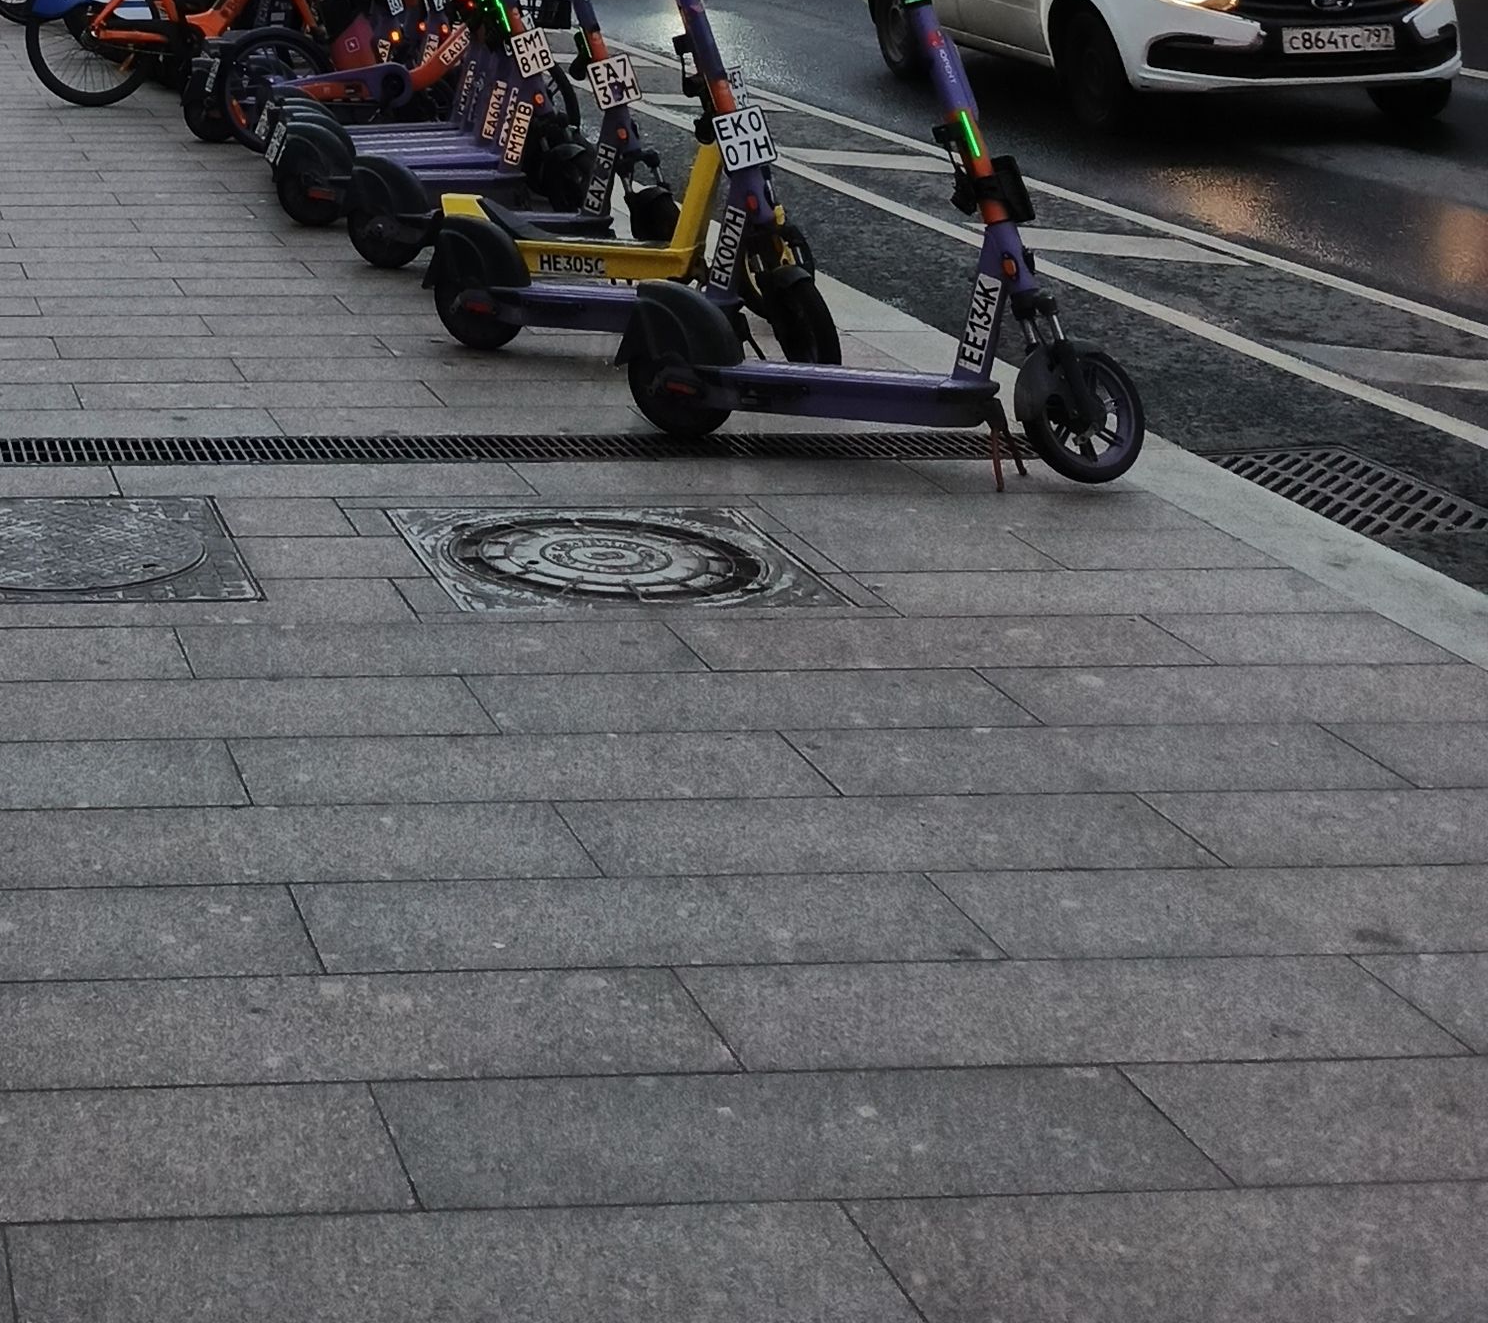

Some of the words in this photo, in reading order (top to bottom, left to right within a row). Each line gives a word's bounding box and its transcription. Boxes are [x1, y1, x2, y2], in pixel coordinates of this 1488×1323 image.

[514, 31, 544, 55] ЕМ1
[1289, 31, 1362, 50] С864ТС
[520, 49, 552, 74] 81В
[590, 57, 628, 86] ЕА7
[598, 77, 639, 106] 3Н
[484, 81, 508, 138] ЕА604Т
[505, 105, 533, 164] ЕМ181В
[715, 111, 763, 141] ЕК0
[725, 135, 773, 166] 07Н
[713, 208, 745, 288] ЕК007Н
[539, 254, 606, 274] НЕ305С
[960, 280, 1000, 367] ЕЕ134К
